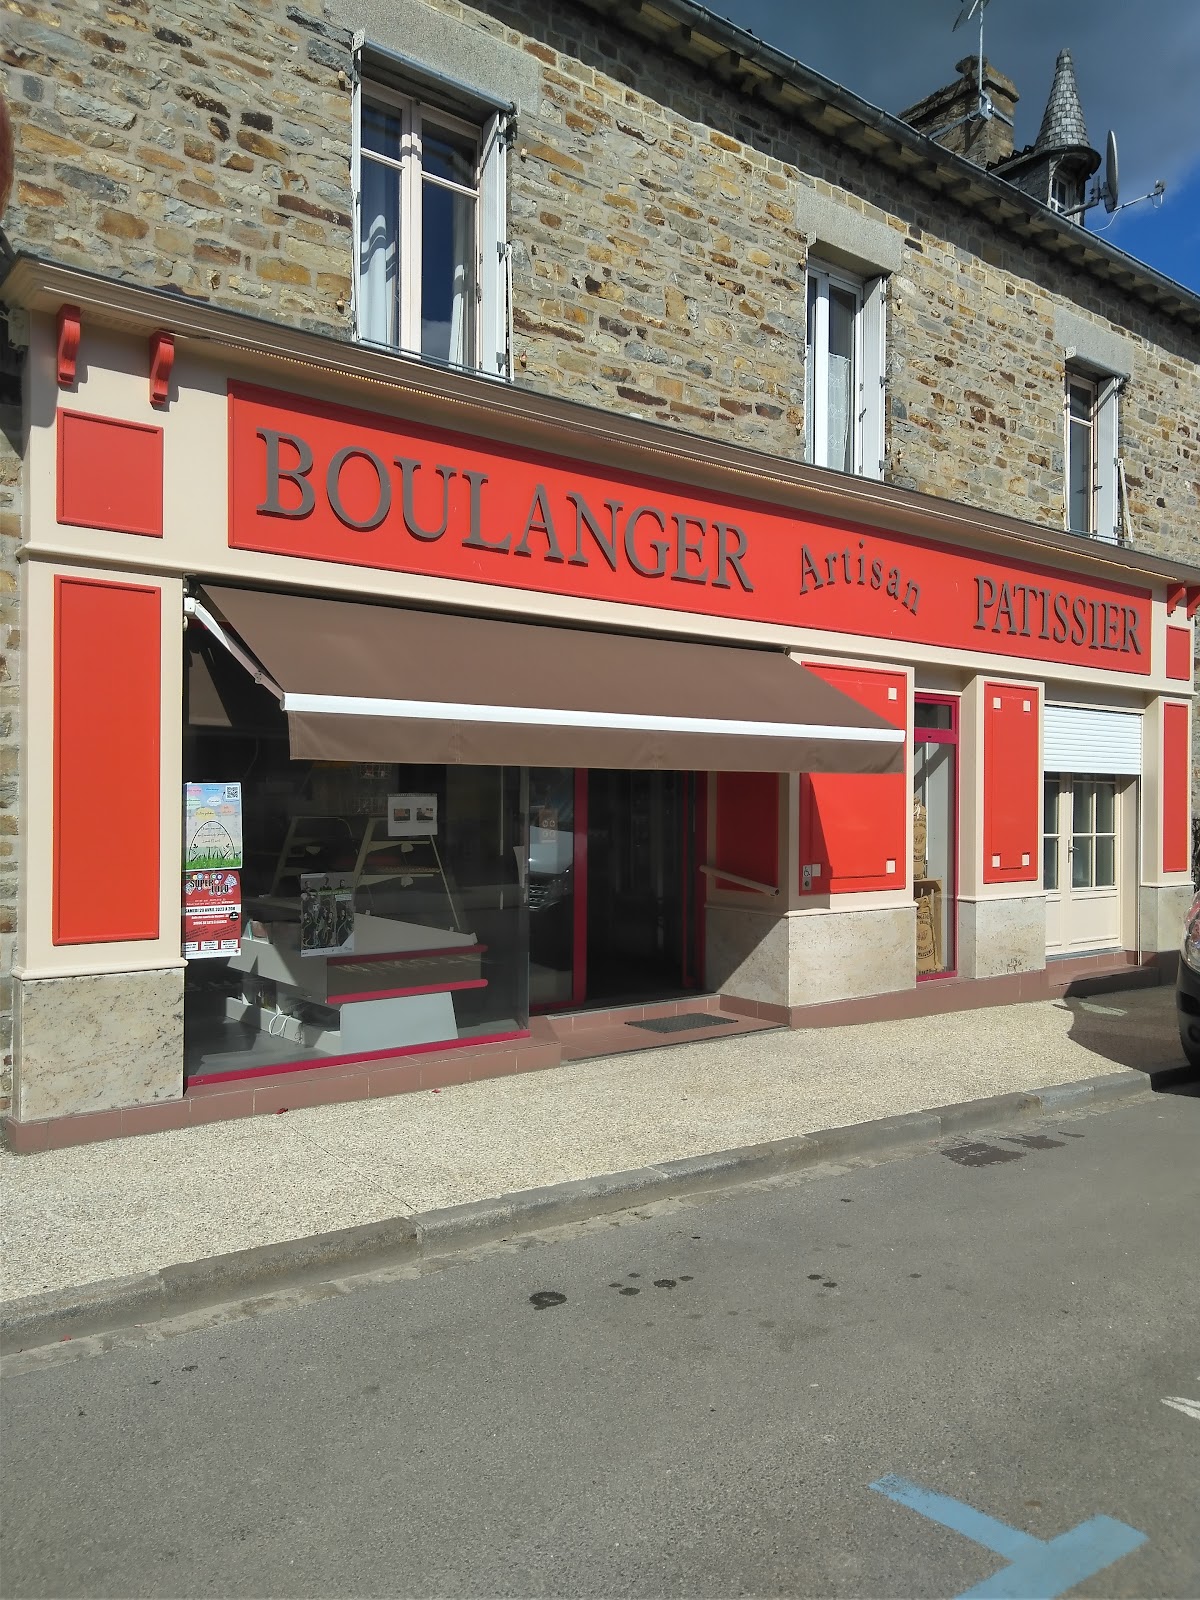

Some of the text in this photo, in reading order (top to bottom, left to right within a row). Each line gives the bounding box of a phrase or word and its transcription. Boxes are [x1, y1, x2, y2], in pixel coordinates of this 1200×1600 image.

[256, 426, 754, 594] BOULANGER
[800, 538, 921, 617] Artisan
[973, 575, 1144, 655] PATISSIER
[189, 879, 214, 888] SUPER
